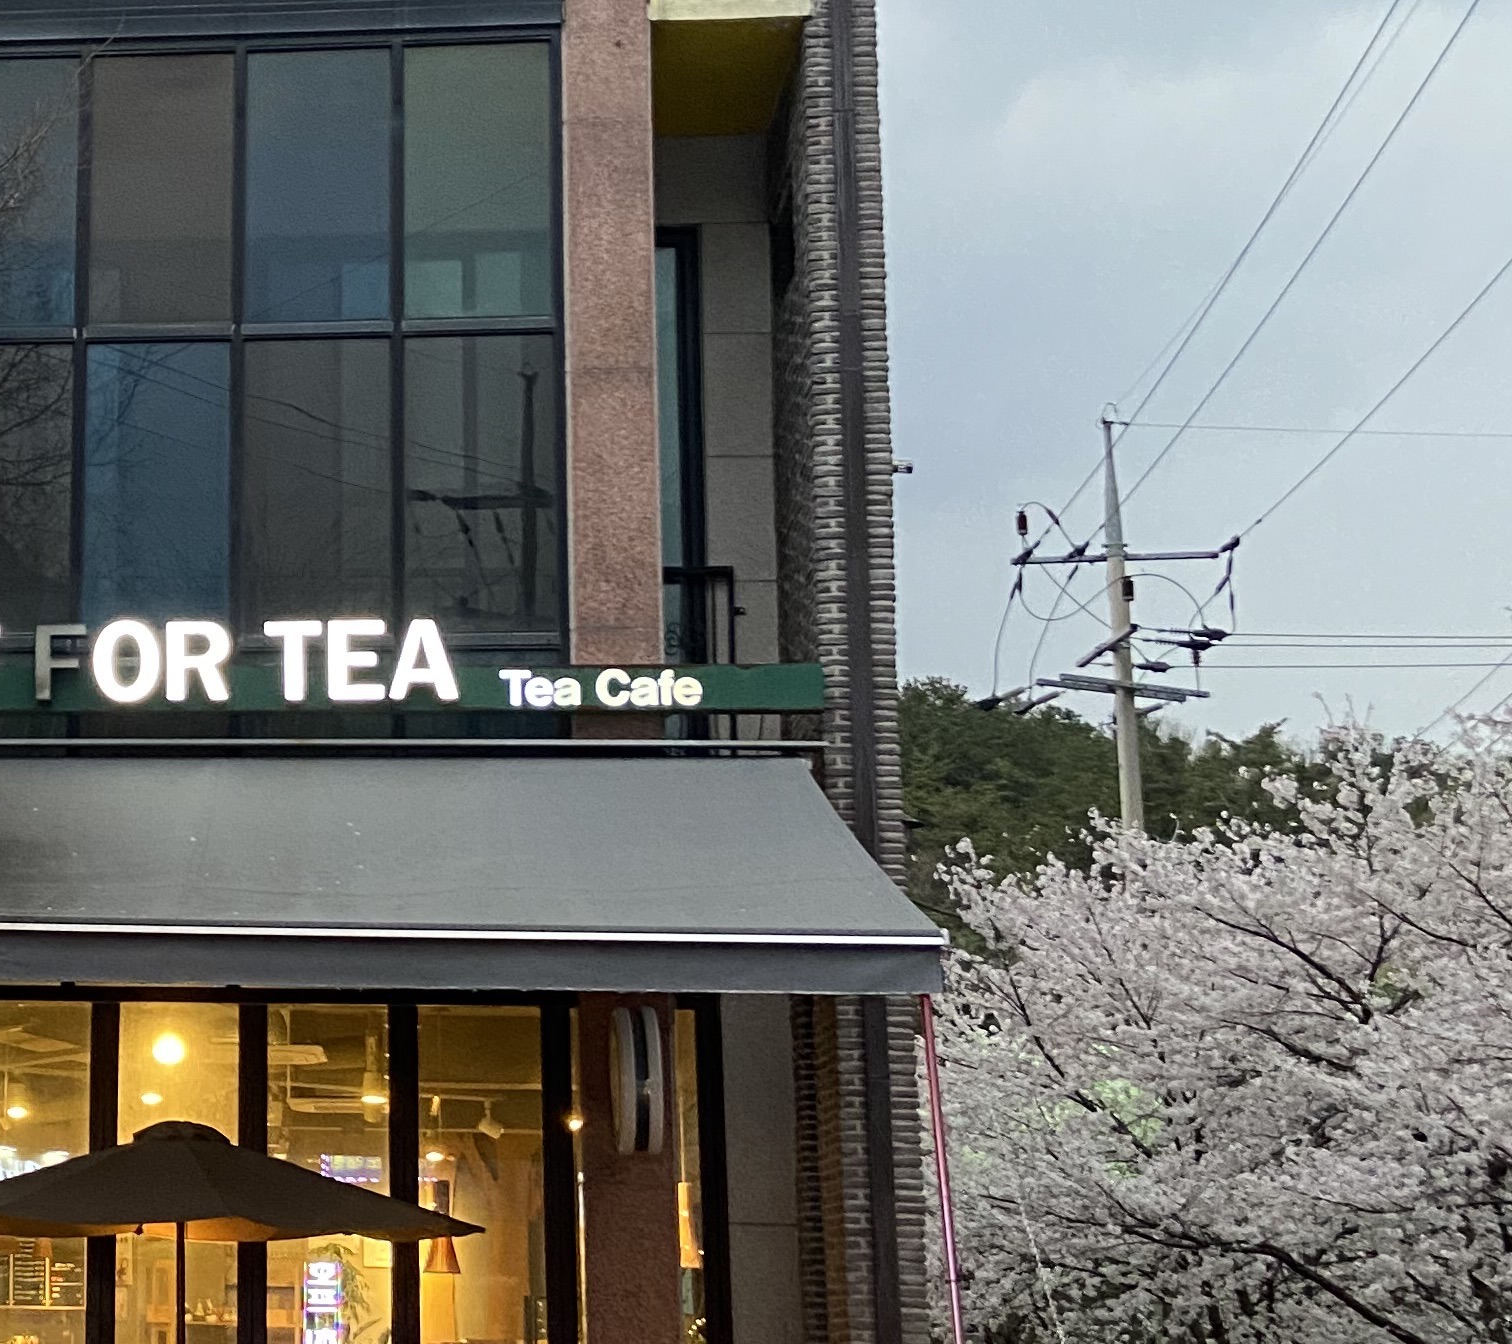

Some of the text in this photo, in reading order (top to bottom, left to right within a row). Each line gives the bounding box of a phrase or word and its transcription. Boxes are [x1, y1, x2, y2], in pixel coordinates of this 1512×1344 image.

[35, 619, 233, 704] FOR
[264, 618, 460, 702] TEA
[498, 667, 704, 709] Tea Cafe
